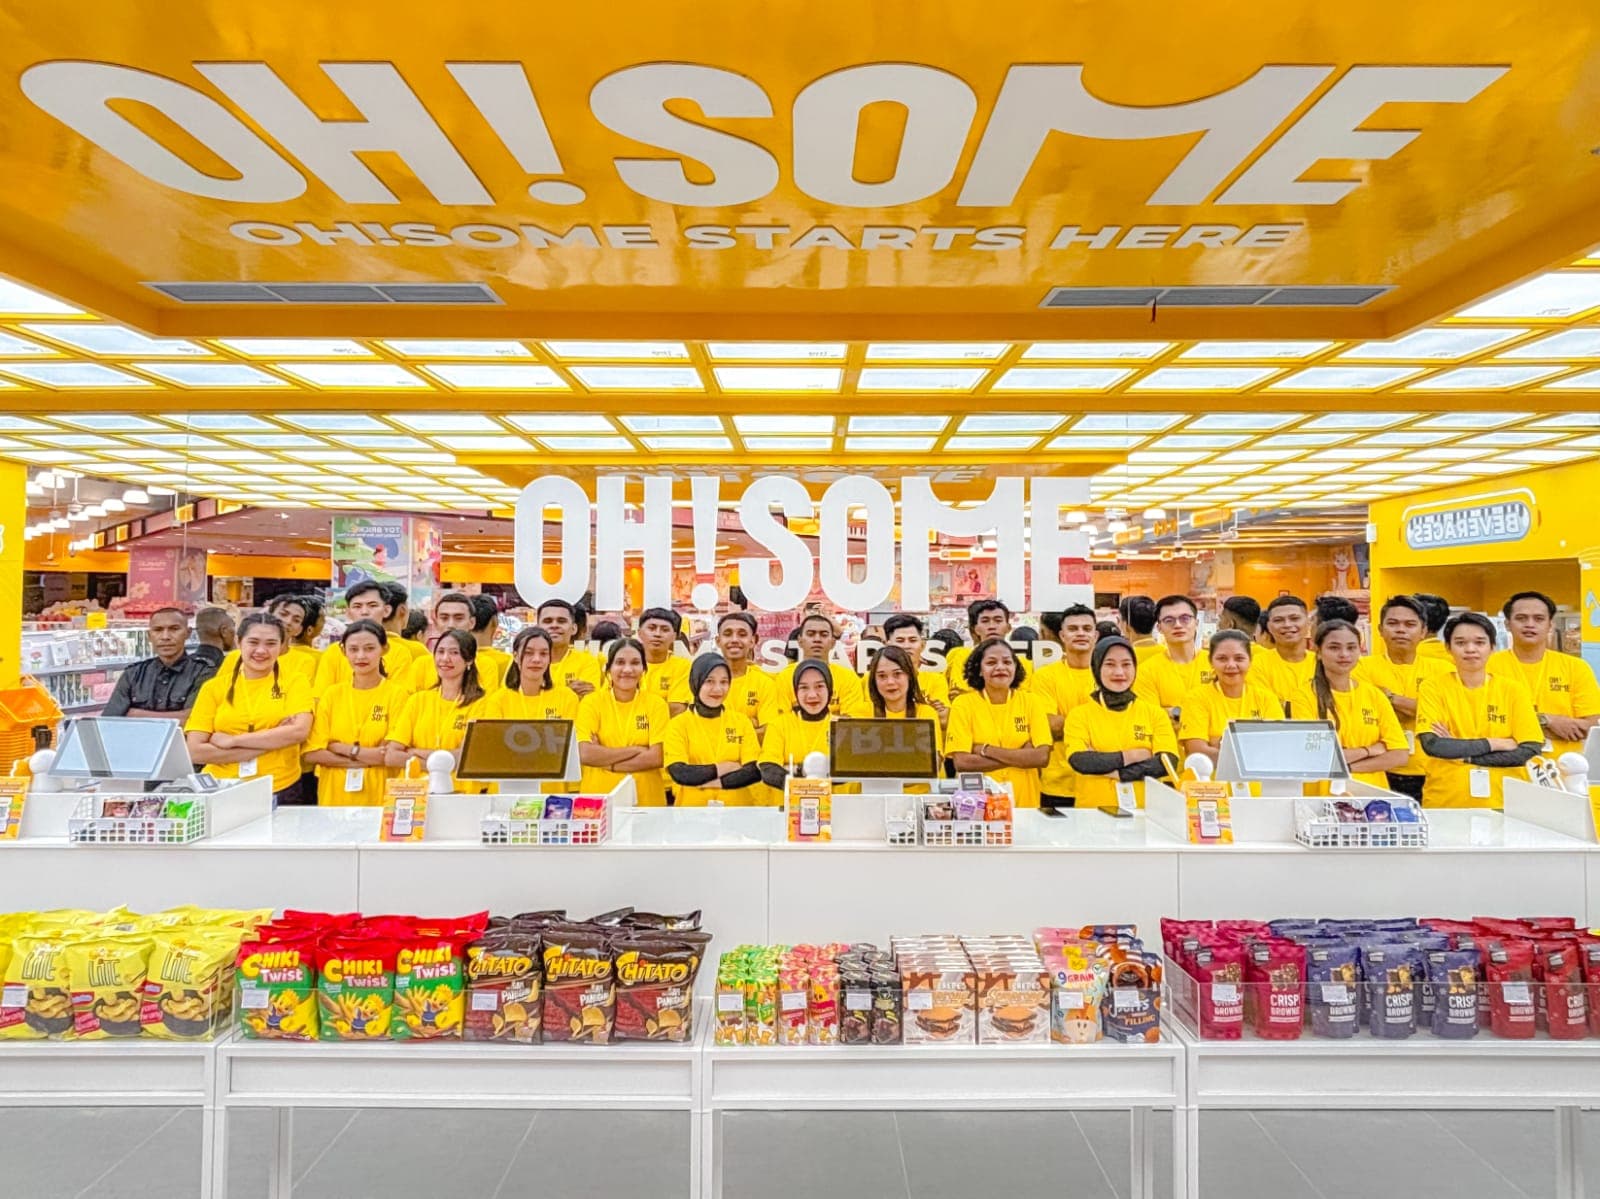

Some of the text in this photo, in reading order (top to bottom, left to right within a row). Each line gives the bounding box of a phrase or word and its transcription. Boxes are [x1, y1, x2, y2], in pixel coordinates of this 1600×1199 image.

[229, 222, 1302, 250] OH!SOME STARTS HERE
[513, 475, 1094, 612] OH!SOME
[241, 951, 300, 977] CHIKI
[324, 959, 383, 982] CHIKI
[397, 946, 452, 974] CHIKI
